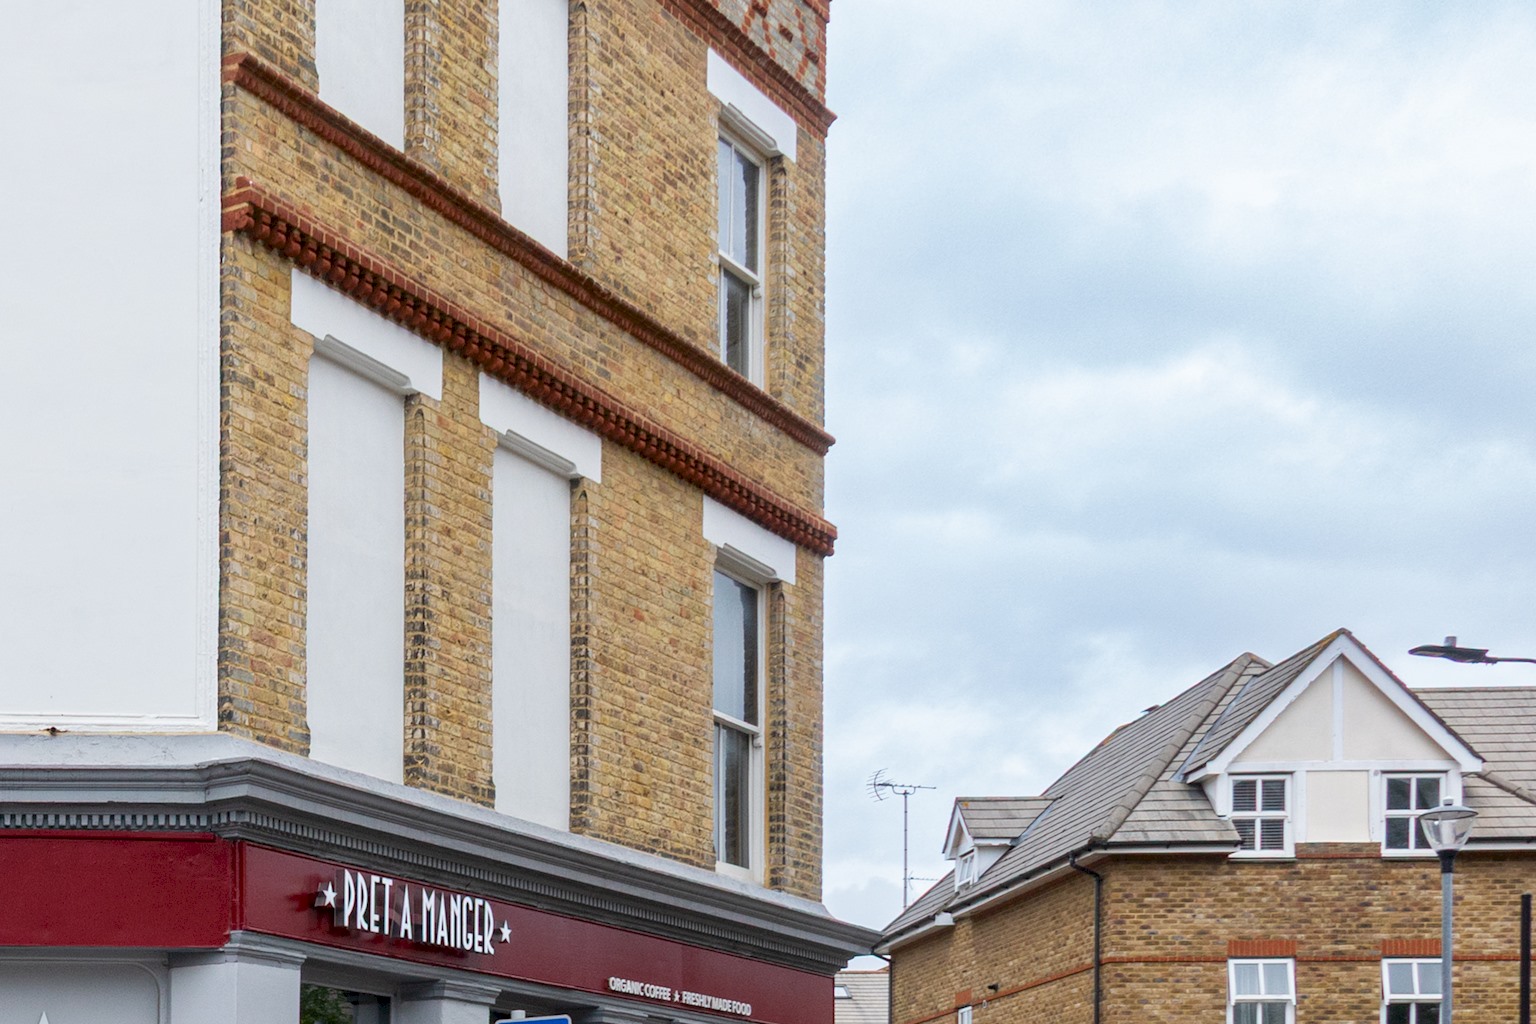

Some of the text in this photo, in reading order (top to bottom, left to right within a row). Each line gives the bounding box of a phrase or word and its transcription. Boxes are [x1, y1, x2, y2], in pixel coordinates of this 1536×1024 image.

[344, 868, 495, 955] PRET A MANGER
[608, 976, 752, 1016] ORGANIC COFFEE FRESHLY MADE FOOD
